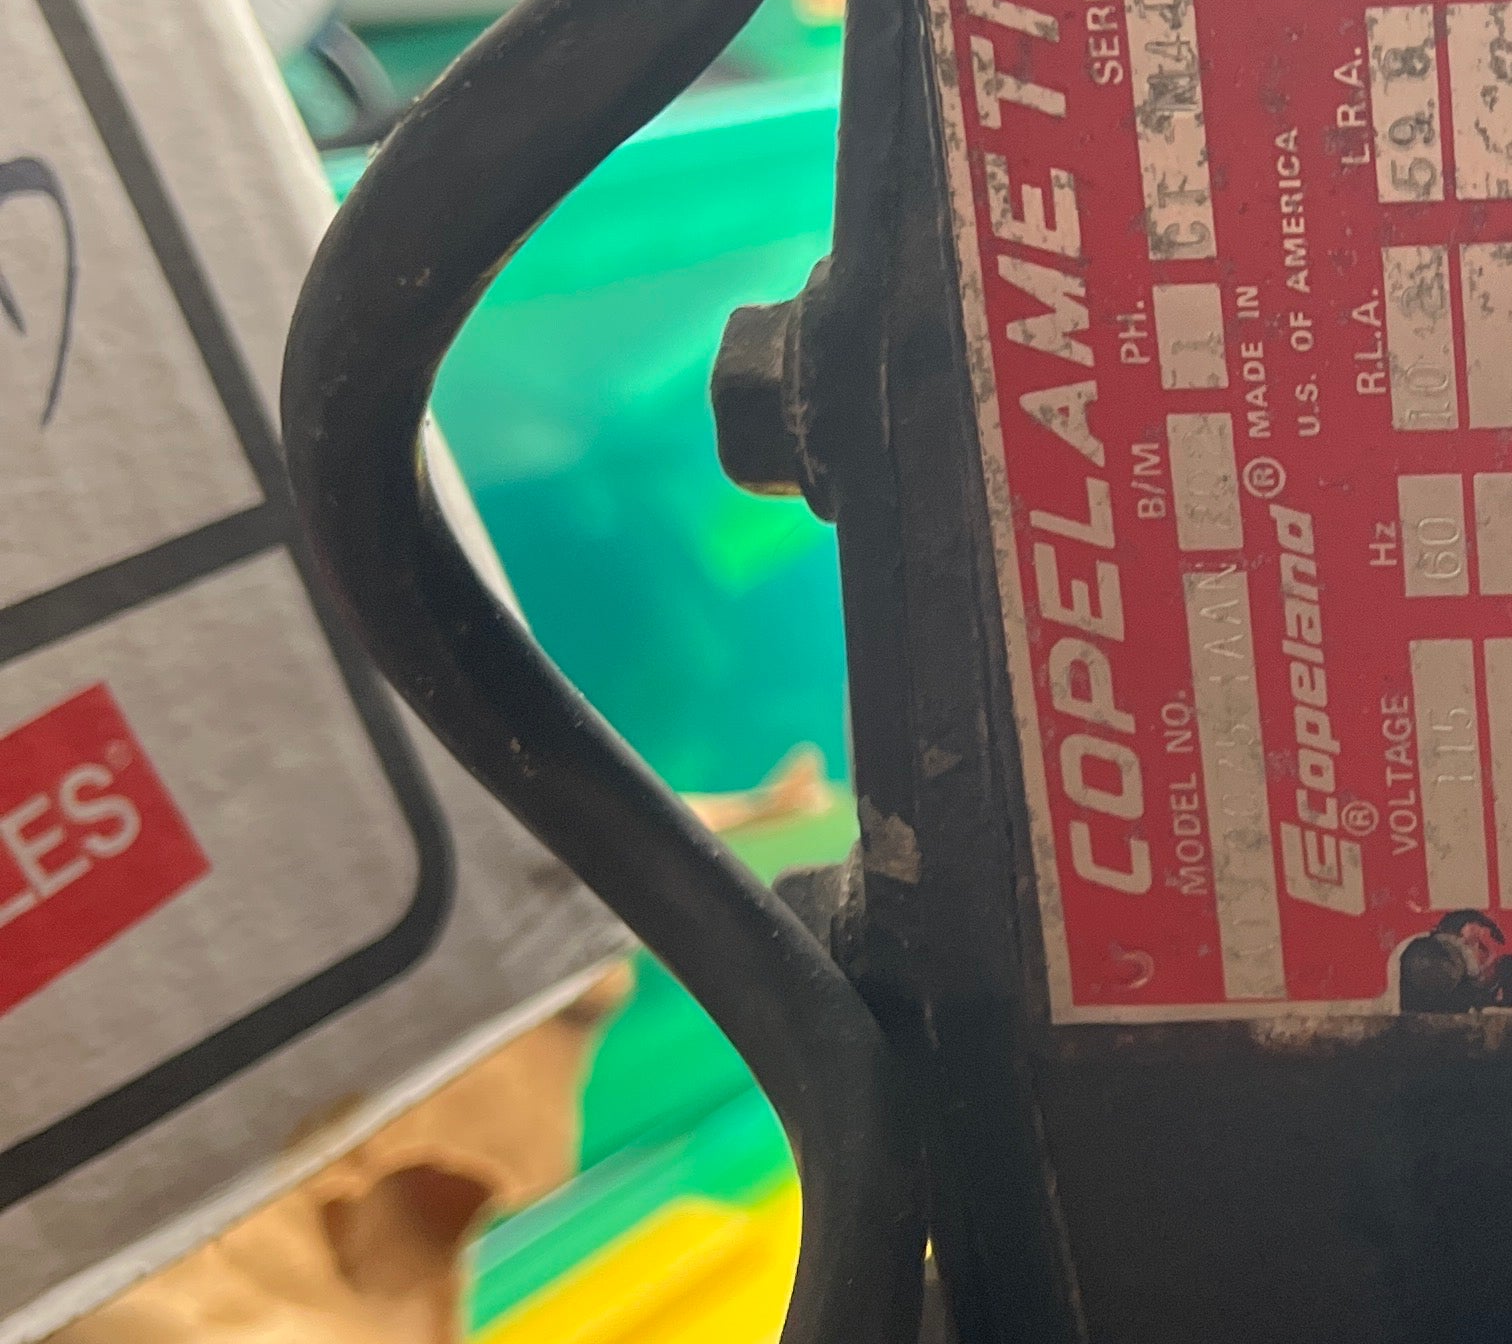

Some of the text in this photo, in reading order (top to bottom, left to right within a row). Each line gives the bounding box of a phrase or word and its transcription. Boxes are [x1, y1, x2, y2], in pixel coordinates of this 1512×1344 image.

[1276, 127, 1310, 291] AMERICA
[1117, 299, 1149, 363] PH.
[1235, 285, 1271, 438] MADE IN
[1288, 309, 1314, 350] OF
[1354, 289, 1386, 394] R.L.A.
[1132, 441, 1166, 519] B/M
[1369, 520, 1398, 564] Hz
[1417, 517, 1462, 579] 60
[1382, 695, 1417, 852] VOLTAGE
[1429, 706, 1476, 785] 115
[1161, 689, 1208, 895] MODEL NO.
